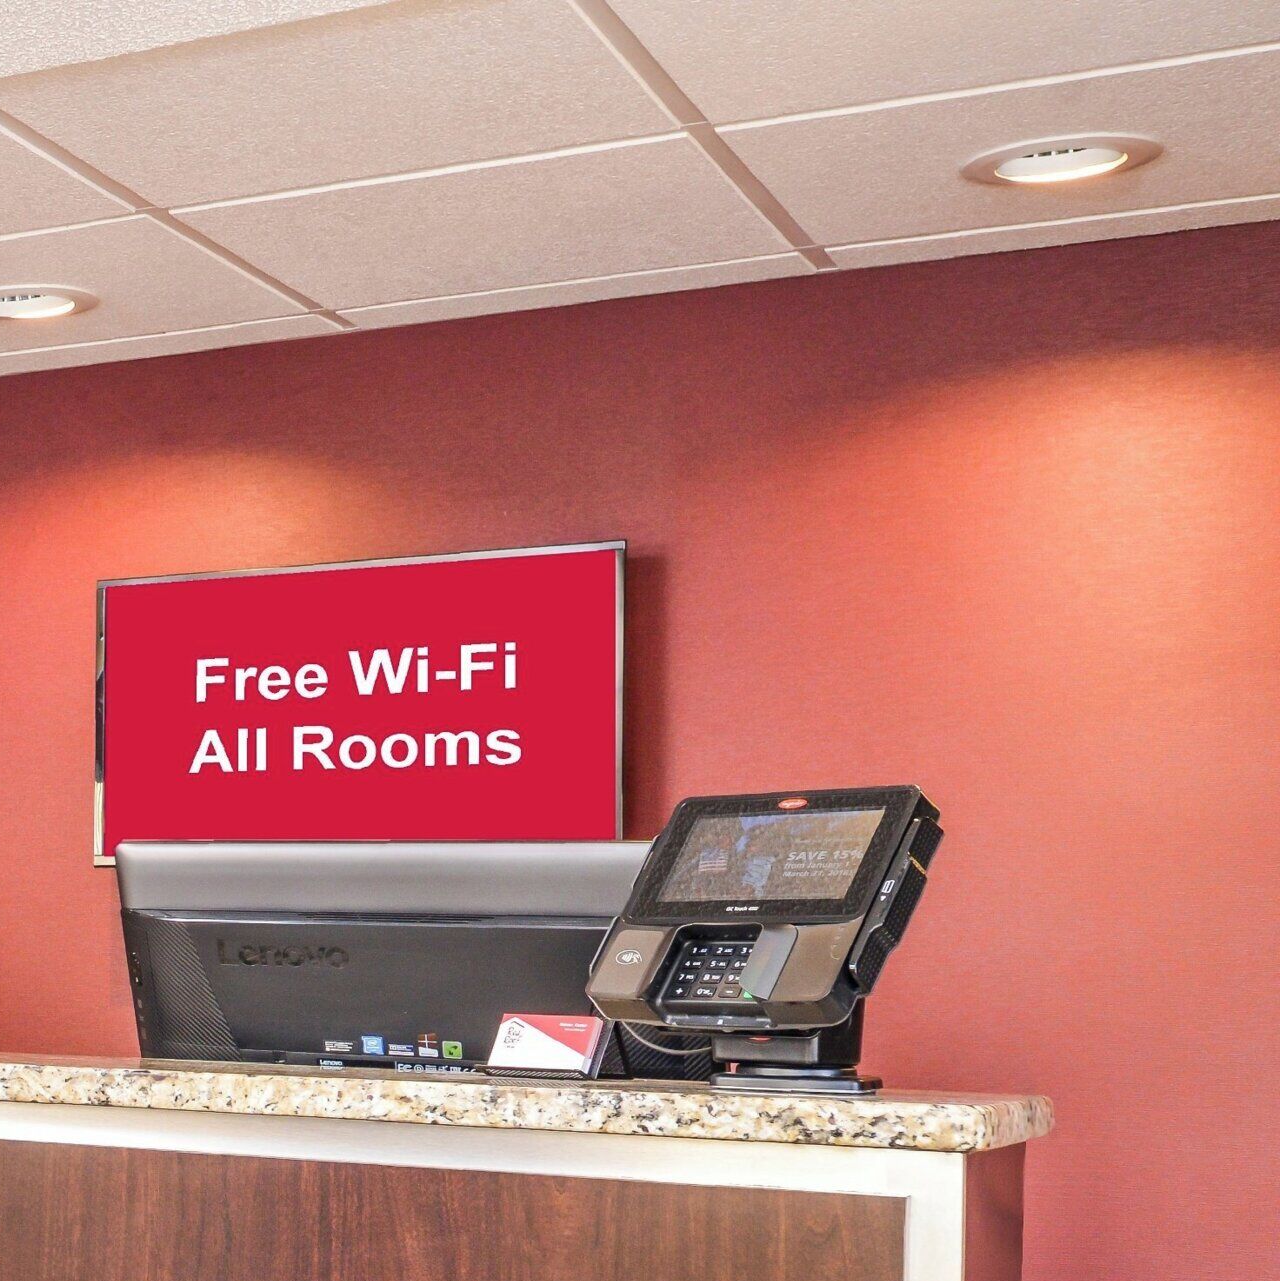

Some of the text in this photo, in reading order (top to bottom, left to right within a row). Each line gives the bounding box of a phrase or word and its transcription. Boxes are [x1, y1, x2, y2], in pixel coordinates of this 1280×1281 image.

[195, 641, 518, 703] Free Wi-Fi
[188, 725, 523, 774] All Rooms
[787, 851, 828, 861] SAVE
[216, 938, 350, 969] Lenovo
